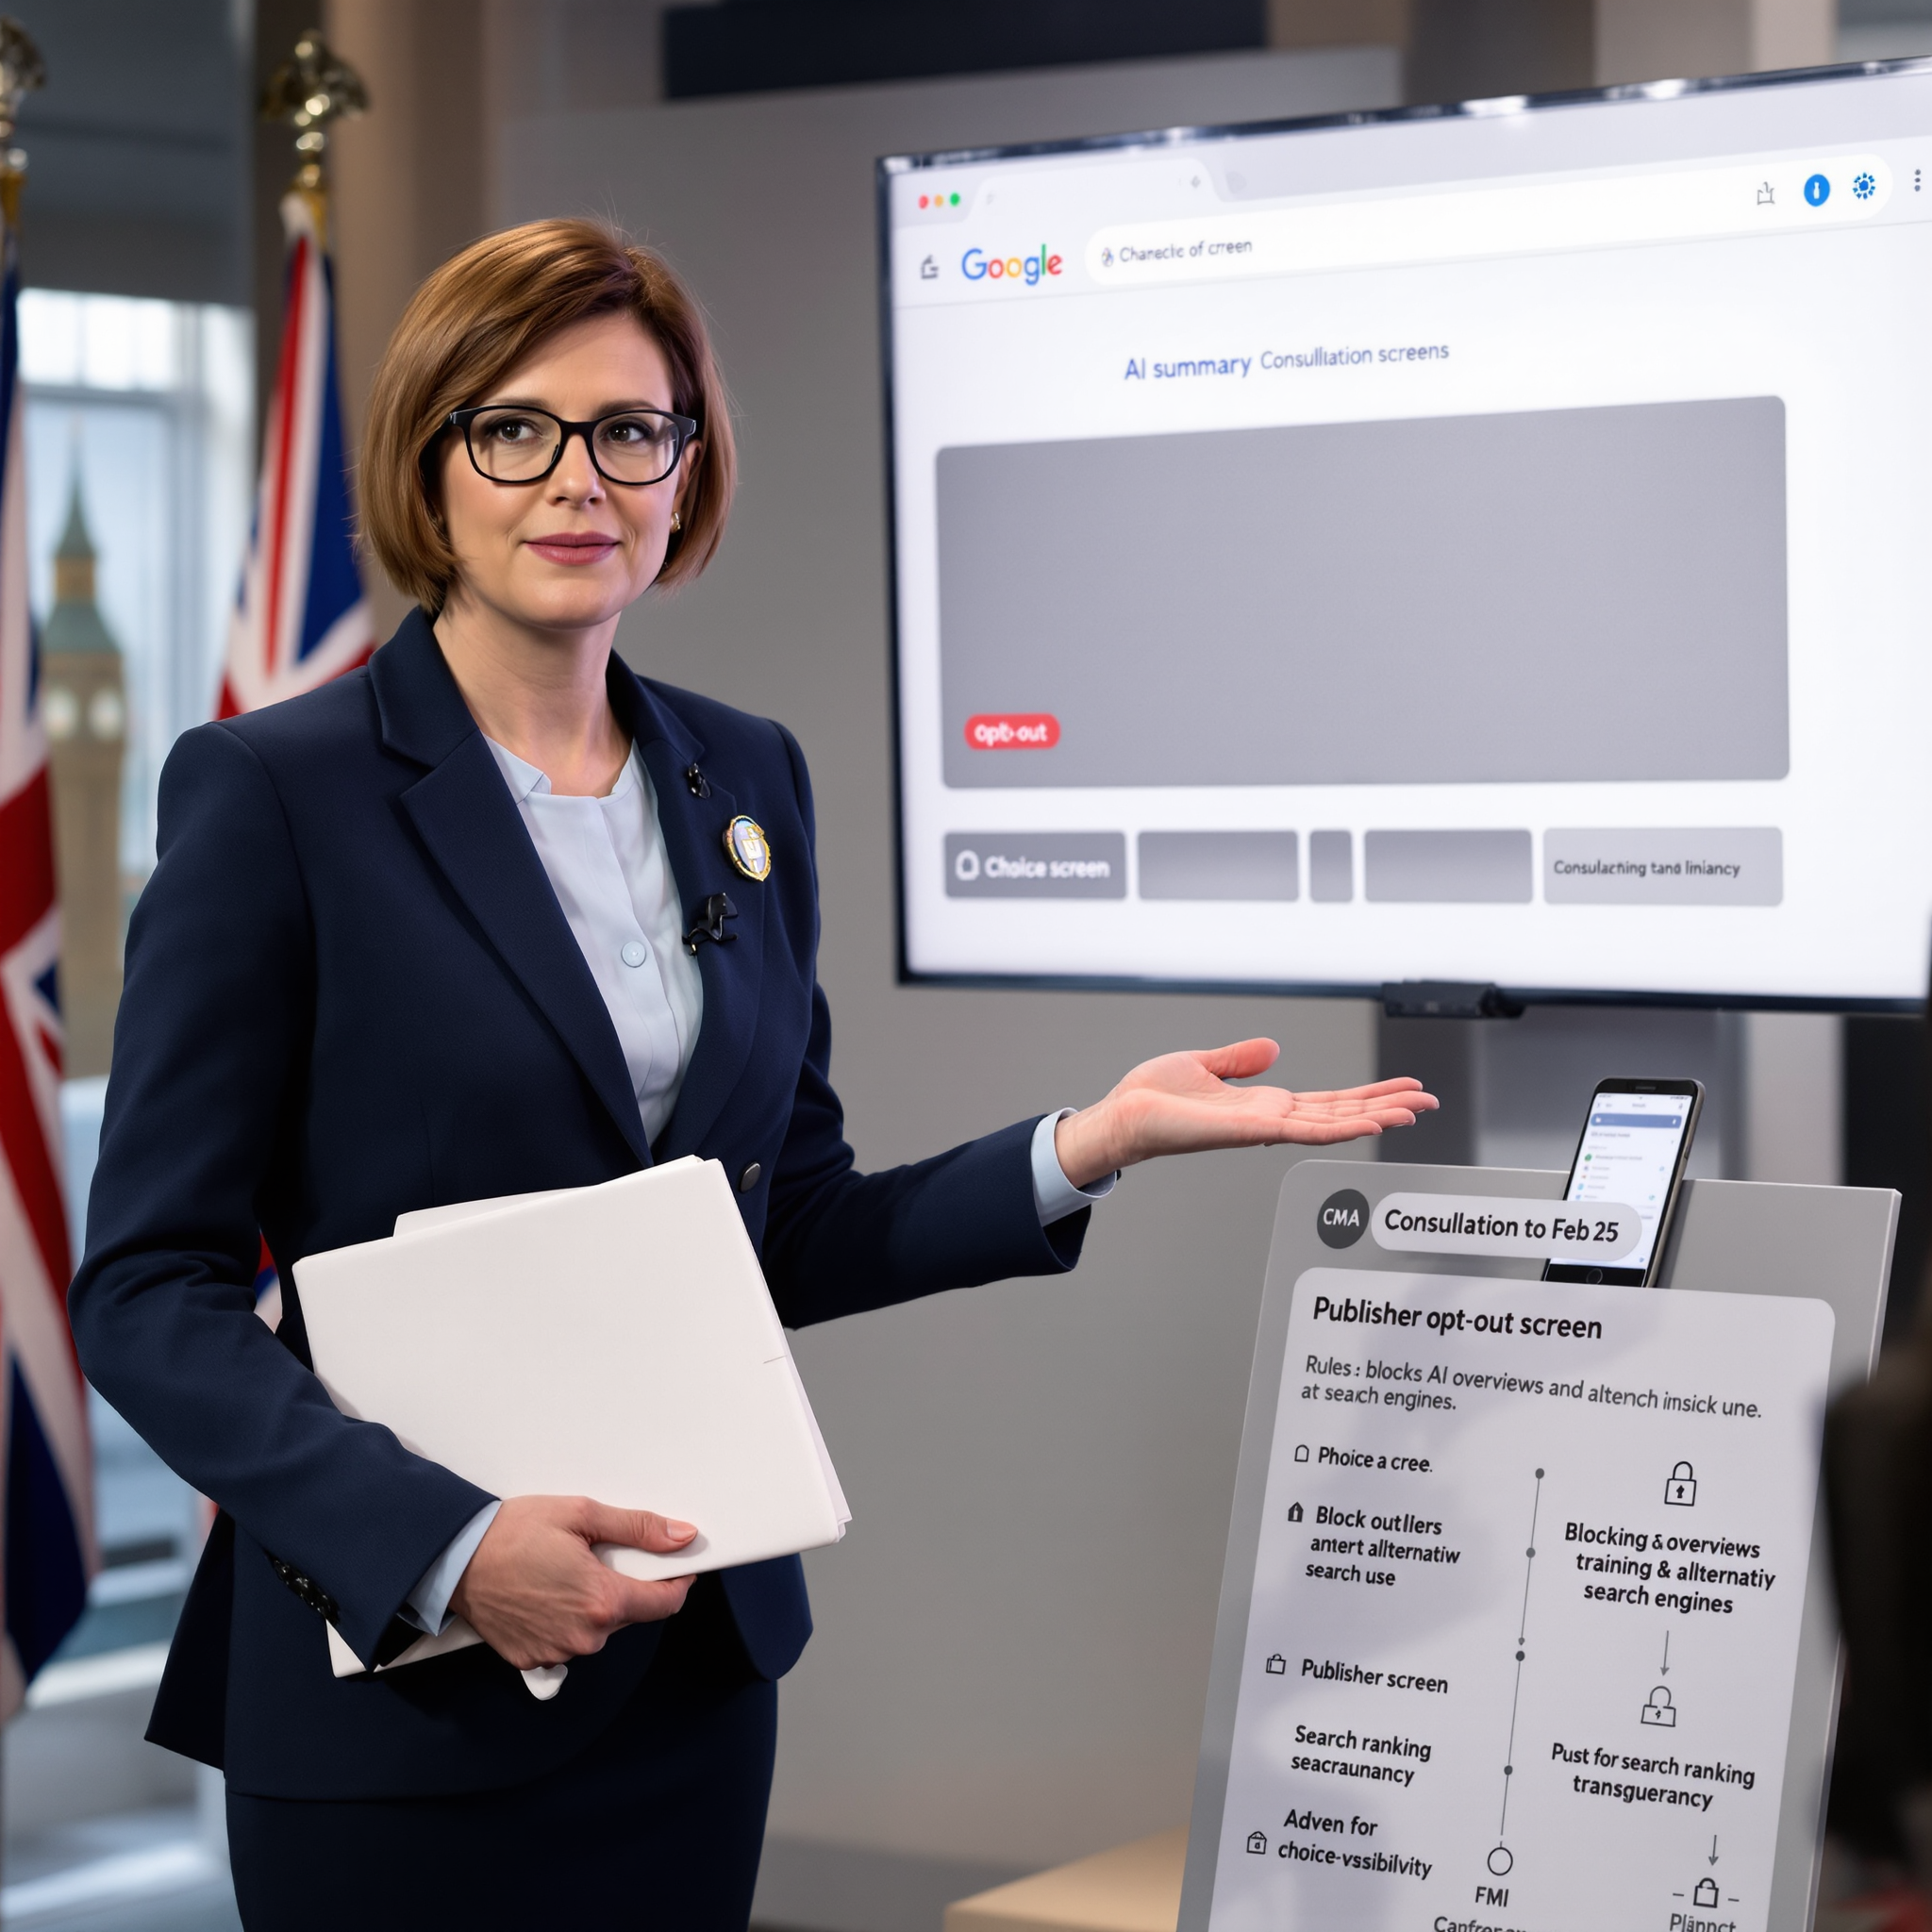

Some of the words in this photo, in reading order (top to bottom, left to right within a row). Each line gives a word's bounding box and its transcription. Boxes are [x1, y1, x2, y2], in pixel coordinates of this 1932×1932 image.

[961, 243, 1062, 285] Google
[1124, 358, 1146, 380] AI
[1154, 356, 1252, 379] summary
[1378, 344, 1449, 363] screens
[985, 855, 1046, 878] Choice
[1050, 860, 1110, 878] screen
[1323, 1208, 1359, 1227] CMA
[1524, 1220, 1546, 1239] to
[1552, 1218, 1590, 1241] Feb
[1592, 1221, 1619, 1242] 25
[1313, 1296, 1422, 1327] Publisher
[1426, 1308, 1513, 1336] opt-out
[1520, 1316, 1603, 1339] screen
[1366, 1359, 1423, 1382] blocks
[1426, 1364, 1449, 1384] AI
[1453, 1371, 1543, 1395] overviews
[1548, 1379, 1584, 1399] and
[1301, 1383, 1320, 1400] at
[1384, 1390, 1457, 1412] engines.
[1319, 1446, 1374, 1468] Phoice
[1377, 1456, 1387, 1469] a
[1316, 1506, 1367, 1528] Block
[1565, 1522, 1648, 1552] Blocking
[1667, 1536, 1760, 1558] overviews
[1306, 1563, 1360, 1582] search
[1366, 1570, 1396, 1586] use
[1576, 1553, 1653, 1580] training
[1657, 1560, 1671, 1579] &
[1584, 1584, 1649, 1606] search
[1655, 1591, 1734, 1614] engines
[1302, 1658, 1383, 1686] Publisher
[1387, 1673, 1448, 1694] screen
[1294, 1724, 1357, 1749] Search
[1362, 1736, 1432, 1763] ranking
[1551, 1742, 1590, 1764] Pust
[1593, 1747, 1619, 1769] for
[1621, 1757, 1679, 1775] search
[1684, 1762, 1756, 1790] ranking
[1284, 1808, 1344, 1833] Adven
[1350, 1816, 1378, 1837] for
